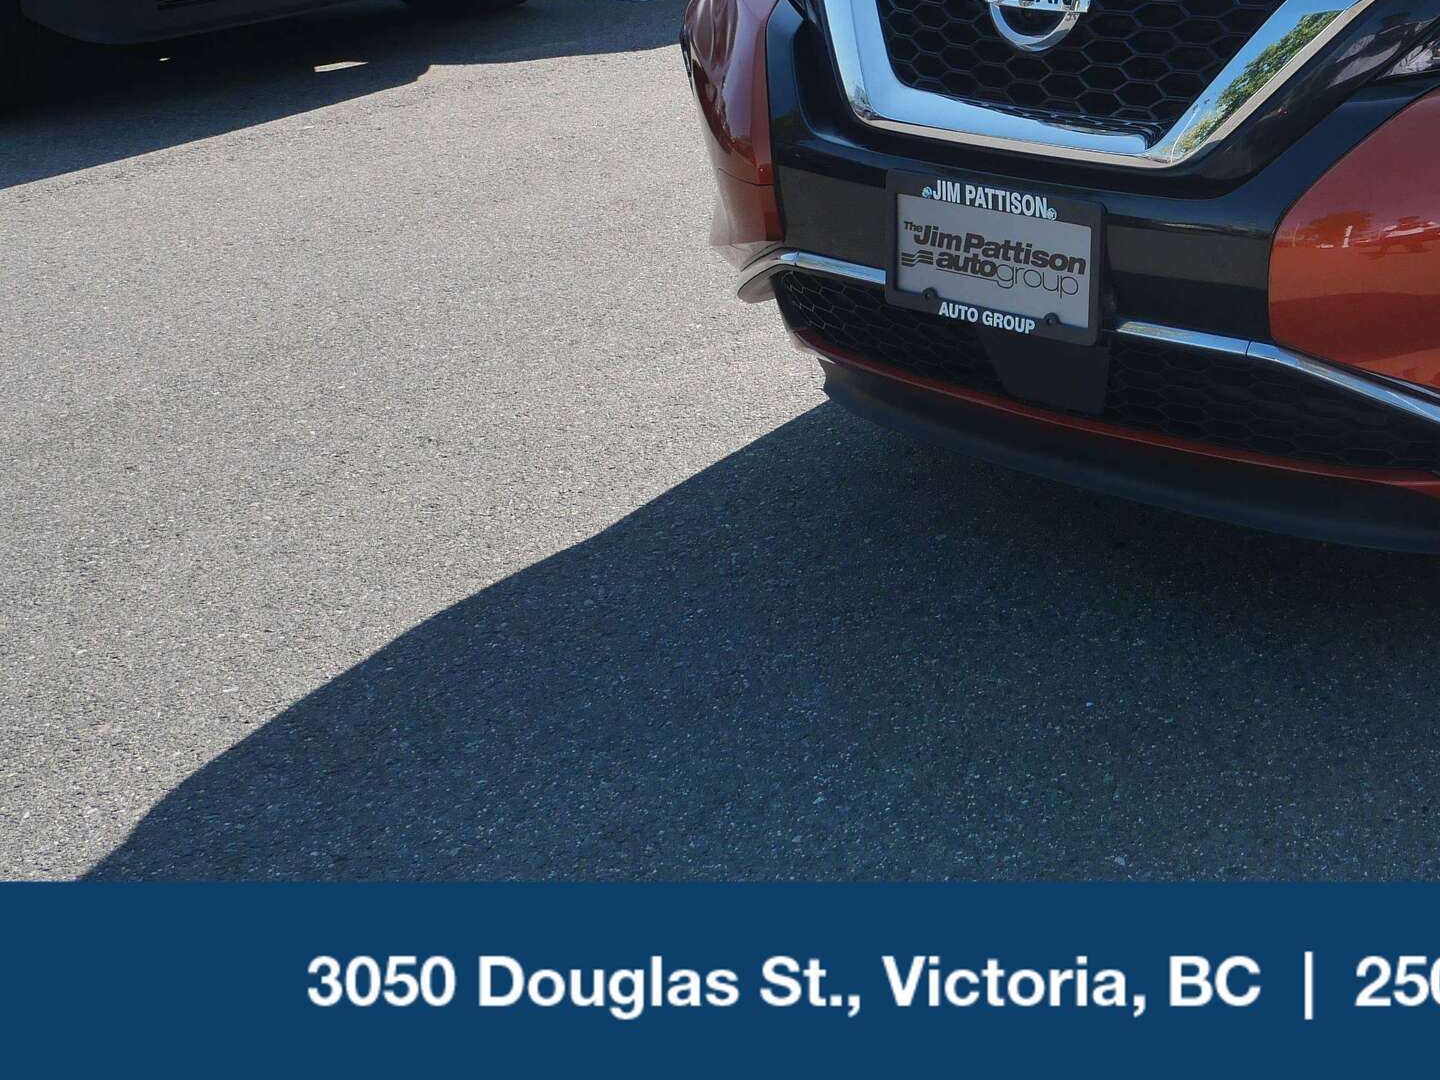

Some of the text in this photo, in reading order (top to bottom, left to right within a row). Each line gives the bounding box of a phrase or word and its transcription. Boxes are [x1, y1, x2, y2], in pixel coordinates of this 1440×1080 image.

[933, 180, 1048, 219] JIM PATTISON
[903, 221, 923, 233] The
[938, 301, 1036, 334] AUTO GROUP
